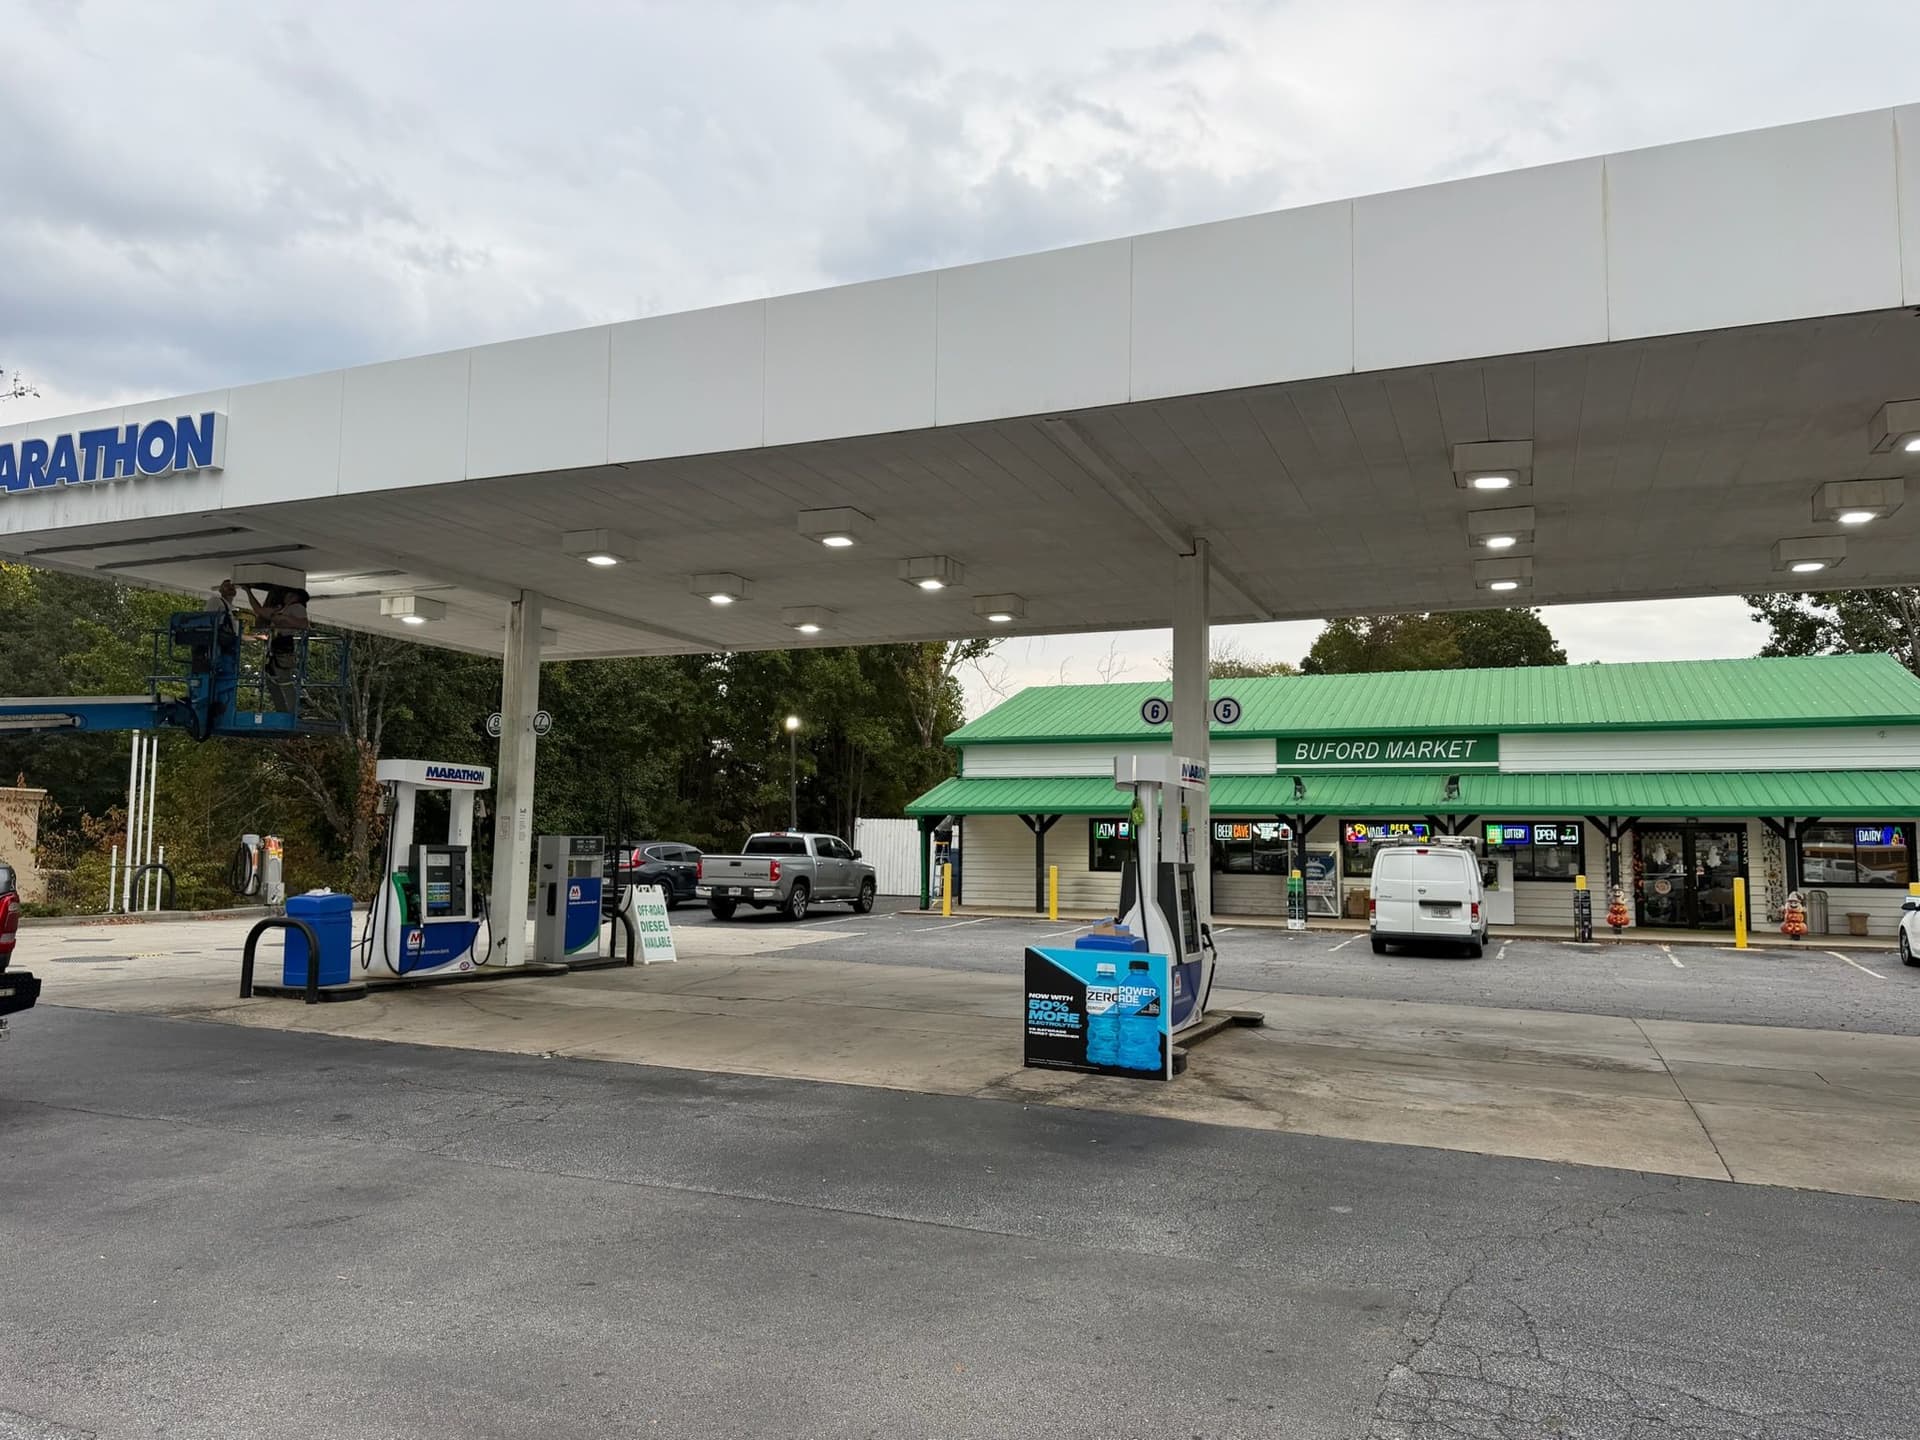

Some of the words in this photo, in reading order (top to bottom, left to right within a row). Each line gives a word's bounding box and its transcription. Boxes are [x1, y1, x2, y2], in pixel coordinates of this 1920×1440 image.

[1150, 704, 1160, 719] 6
[1222, 703, 1232, 718] 5
[538, 715, 546, 727] 7
[1295, 741, 1380, 760] BUFORD
[1385, 739, 1478, 759] MARKET
[425, 766, 485, 782] MARATHON
[1098, 823, 1116, 837] ATM
[1217, 824, 1232, 838] BEER
[1233, 824, 1249, 838] CAVE
[1390, 823, 1410, 831] BEER
[1503, 828, 1526, 839] LOTTERY
[1536, 829, 1557, 841] OPEN
[1858, 829, 1882, 843] DAIRY
[637, 904, 666, 916] OFF-ROAD
[640, 920, 669, 933] DIESEL
[643, 936, 672, 949] AVAILABLE
[1028, 992, 1050, 1000] NOW
[1050, 994, 1074, 1002] WITH
[1118, 985, 1157, 997] POWER
[1028, 999, 1069, 1012] 50%
[1118, 994, 1140, 1004] ADE
[1028, 1009, 1081, 1024] MORE
